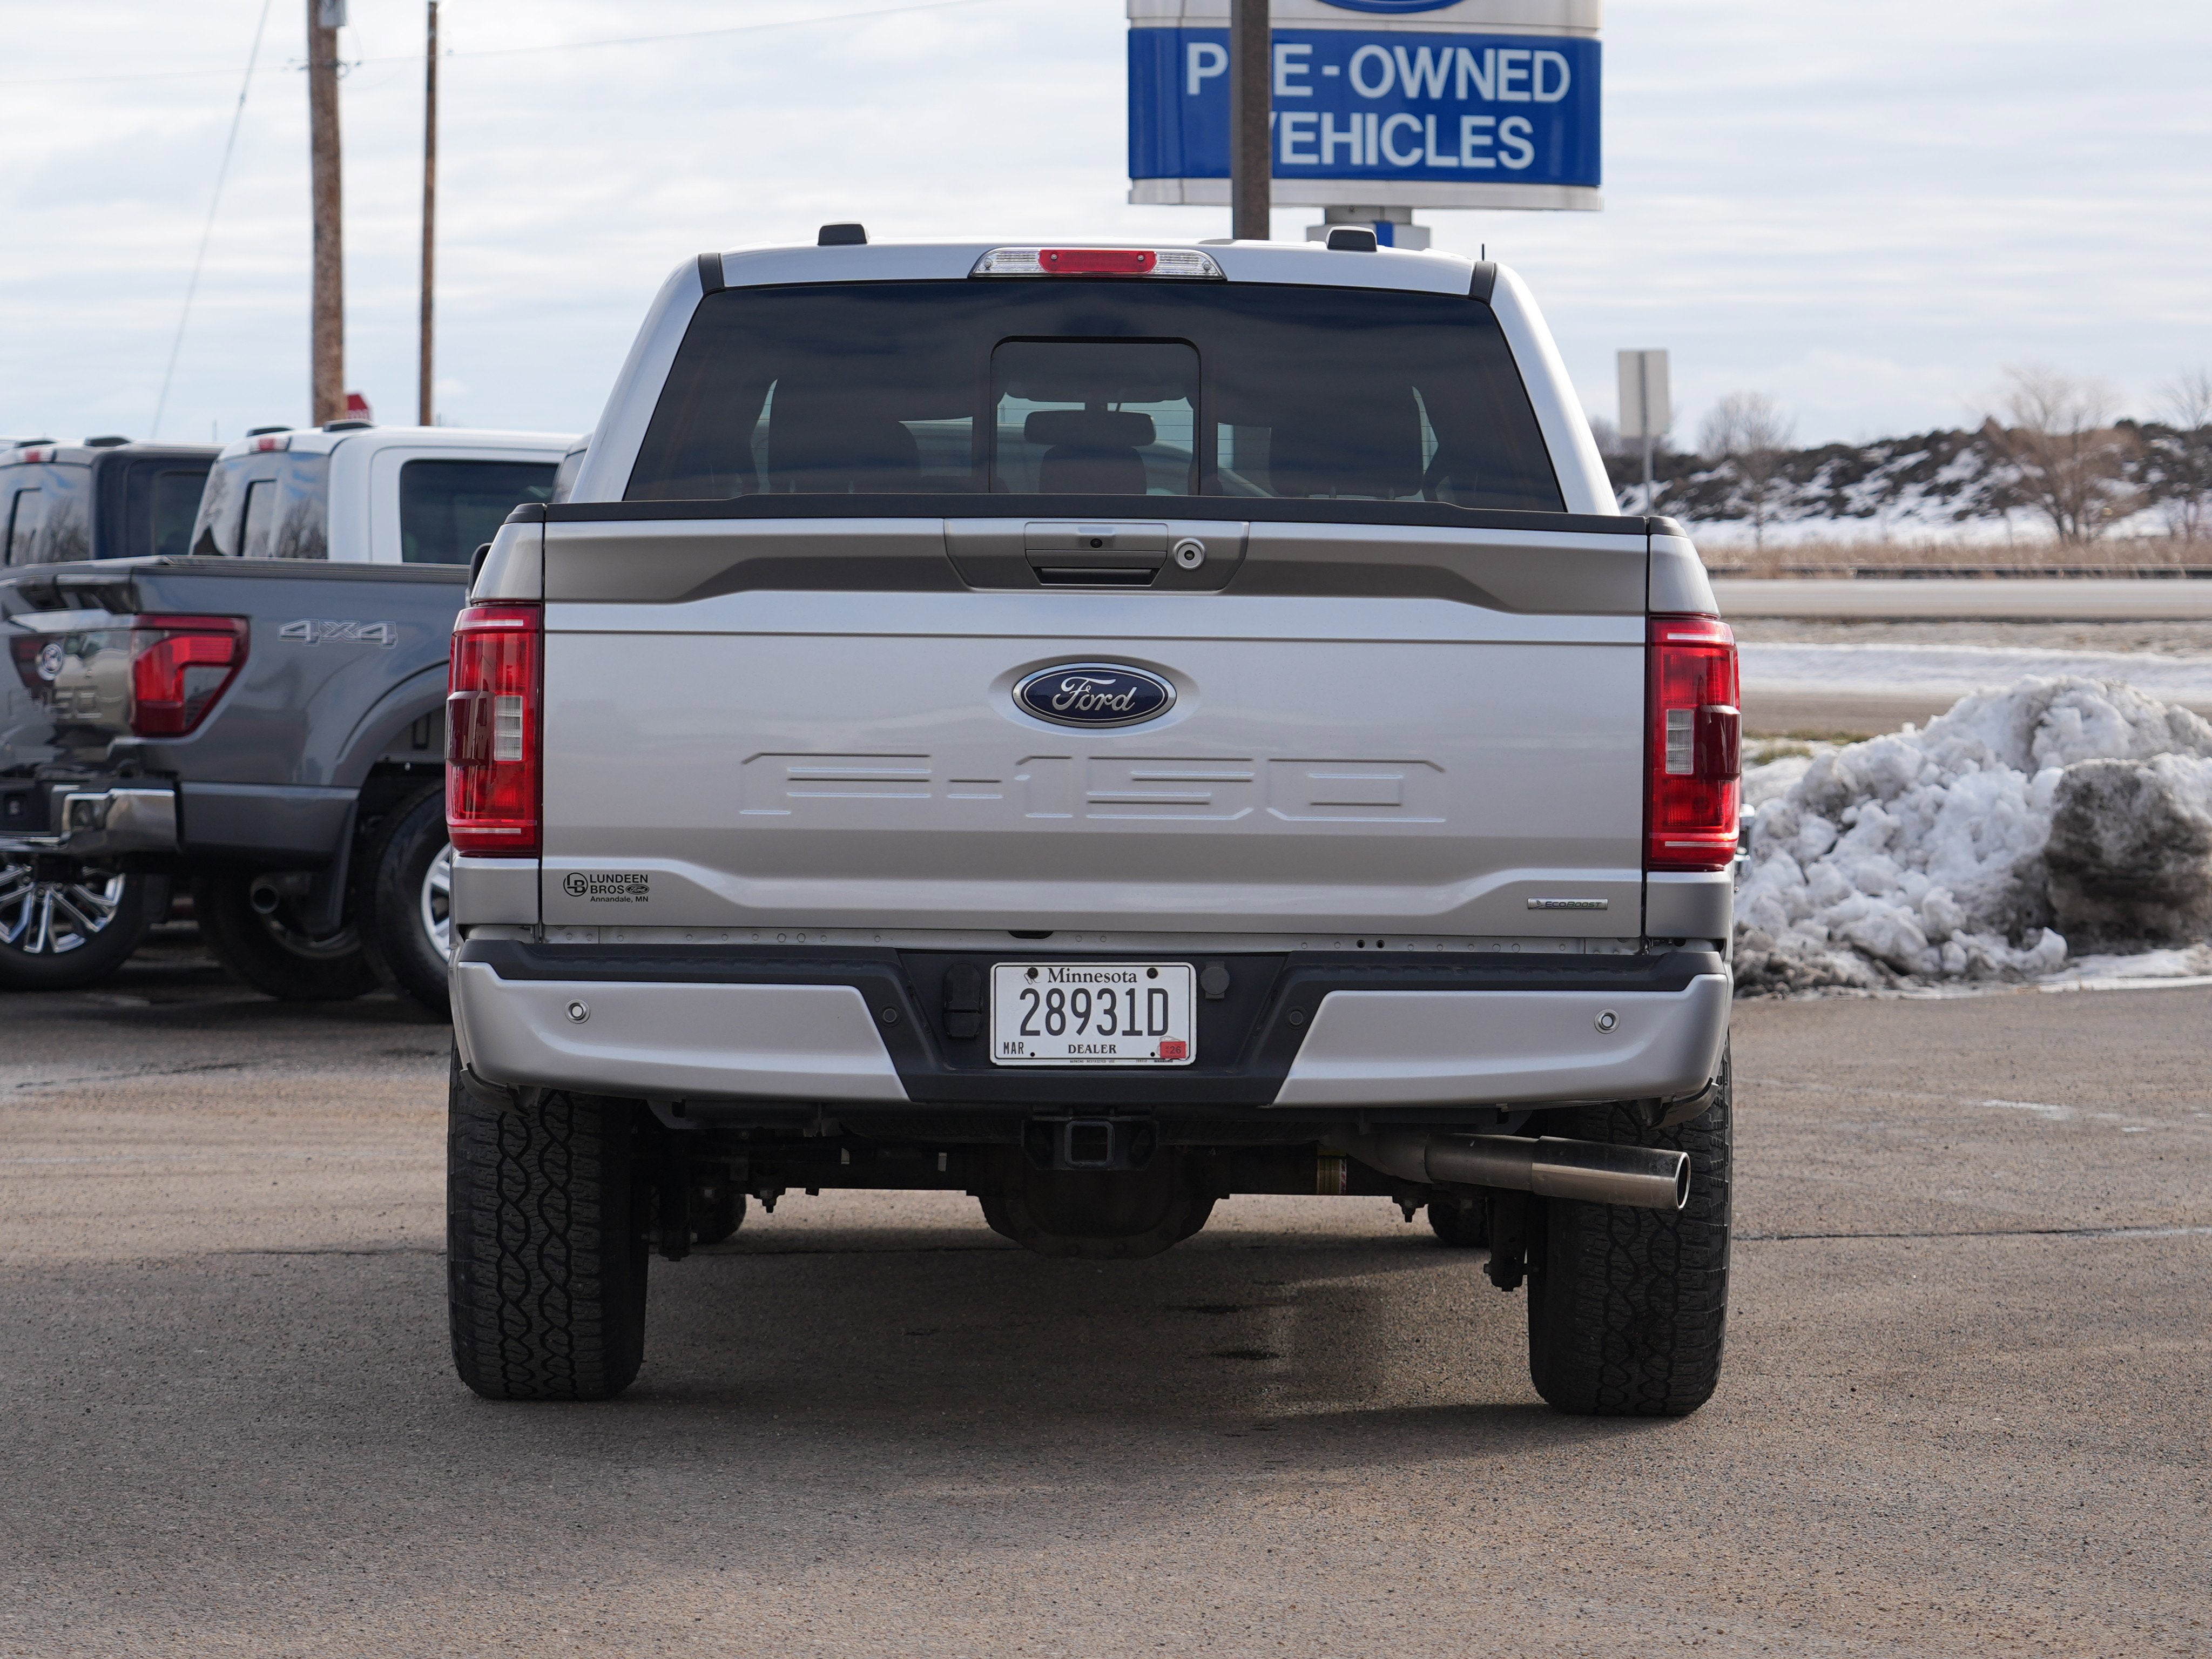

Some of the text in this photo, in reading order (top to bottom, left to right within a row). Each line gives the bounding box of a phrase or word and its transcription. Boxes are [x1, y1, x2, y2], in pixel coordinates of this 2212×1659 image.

[1187, 43, 1571, 103] PE-OWNED
[1269, 112, 1535, 170] EHICLES
[1052, 676, 1137, 711] Ford
[590, 874, 648, 884] LUNDEEN
[590, 885, 624, 894] BROS
[1047, 967, 1138, 983] Minnesota
[1019, 988, 1169, 1036] 28931D
[1003, 1042, 1024, 1055] MAR
[1068, 1044, 1117, 1054] DEALER
[1170, 1046, 1181, 1054] 26
